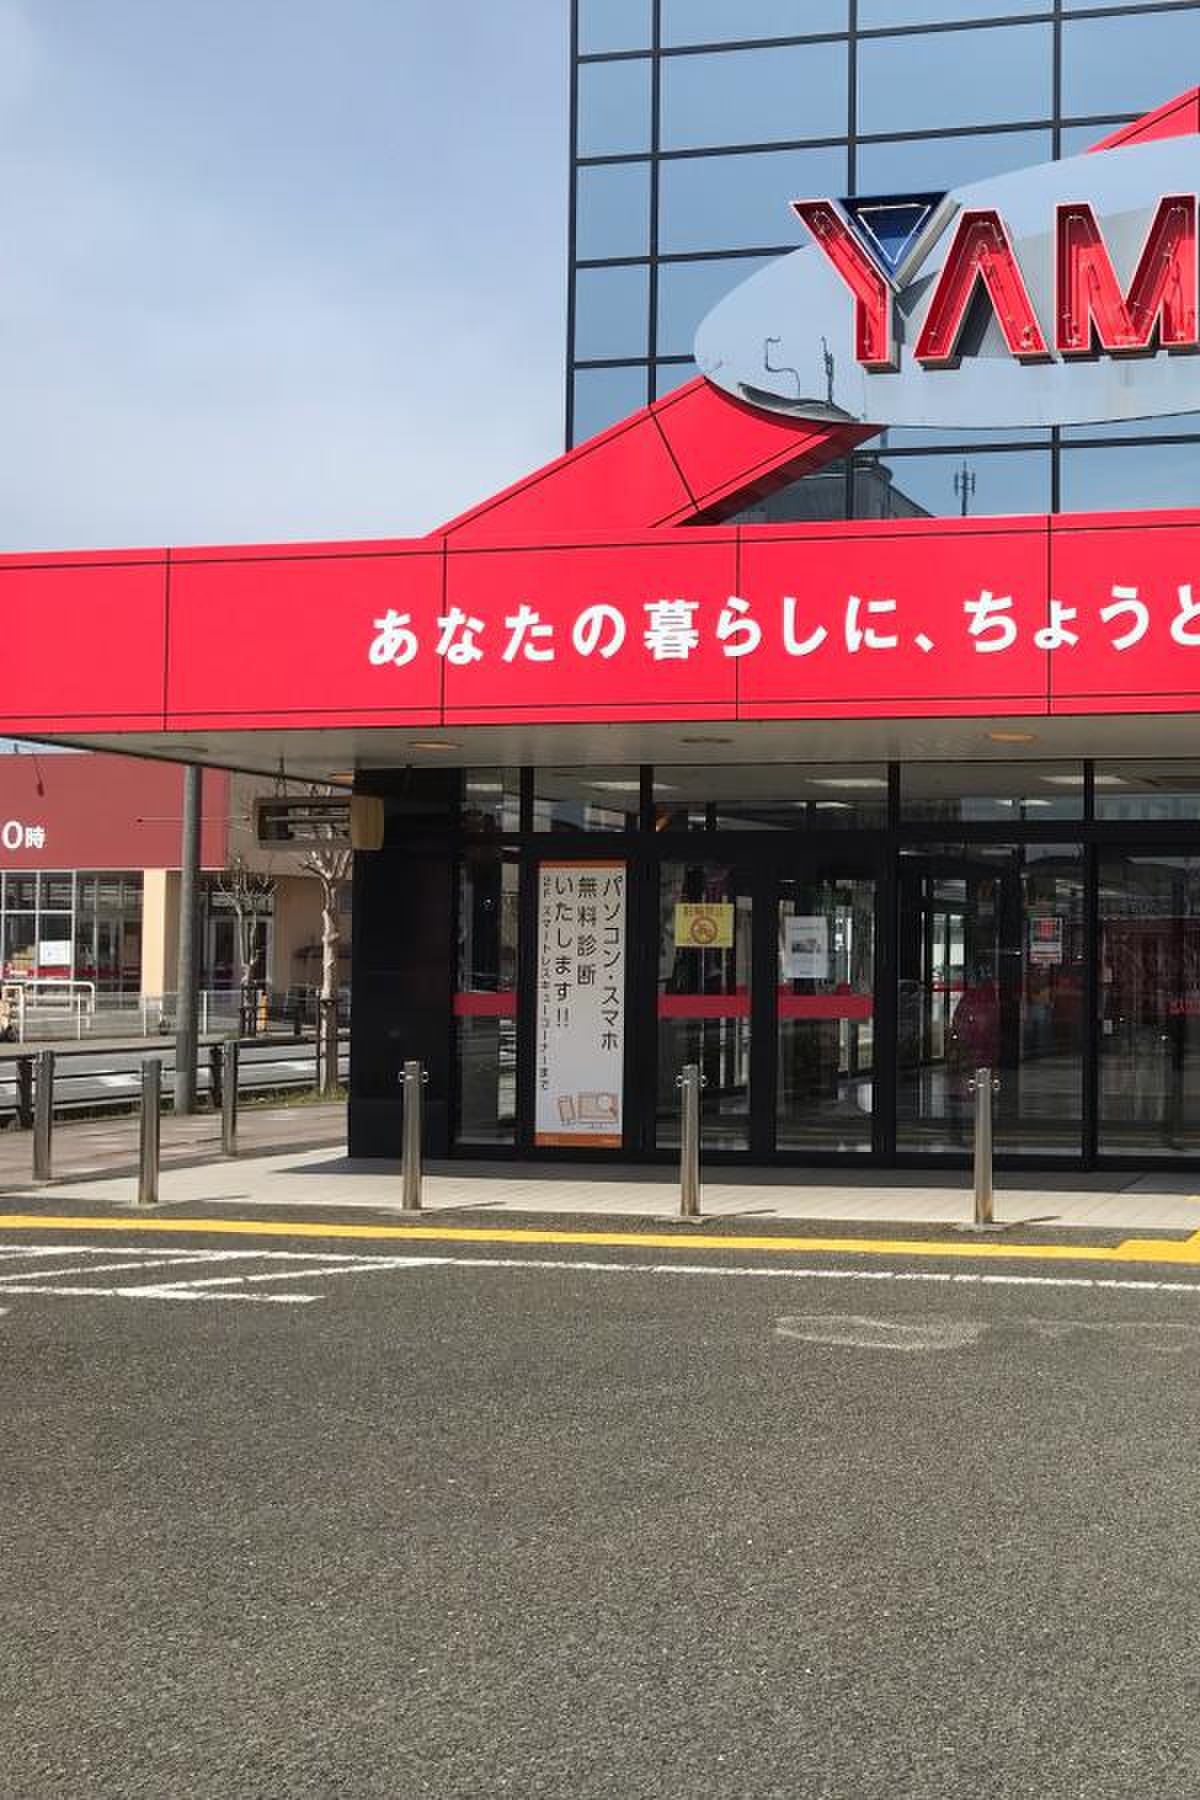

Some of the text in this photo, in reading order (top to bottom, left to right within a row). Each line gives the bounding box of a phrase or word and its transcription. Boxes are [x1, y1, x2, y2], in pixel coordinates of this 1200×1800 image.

[577, 875, 598, 986] 無料診断
[601, 875, 623, 1050] パソコン・スマホ
